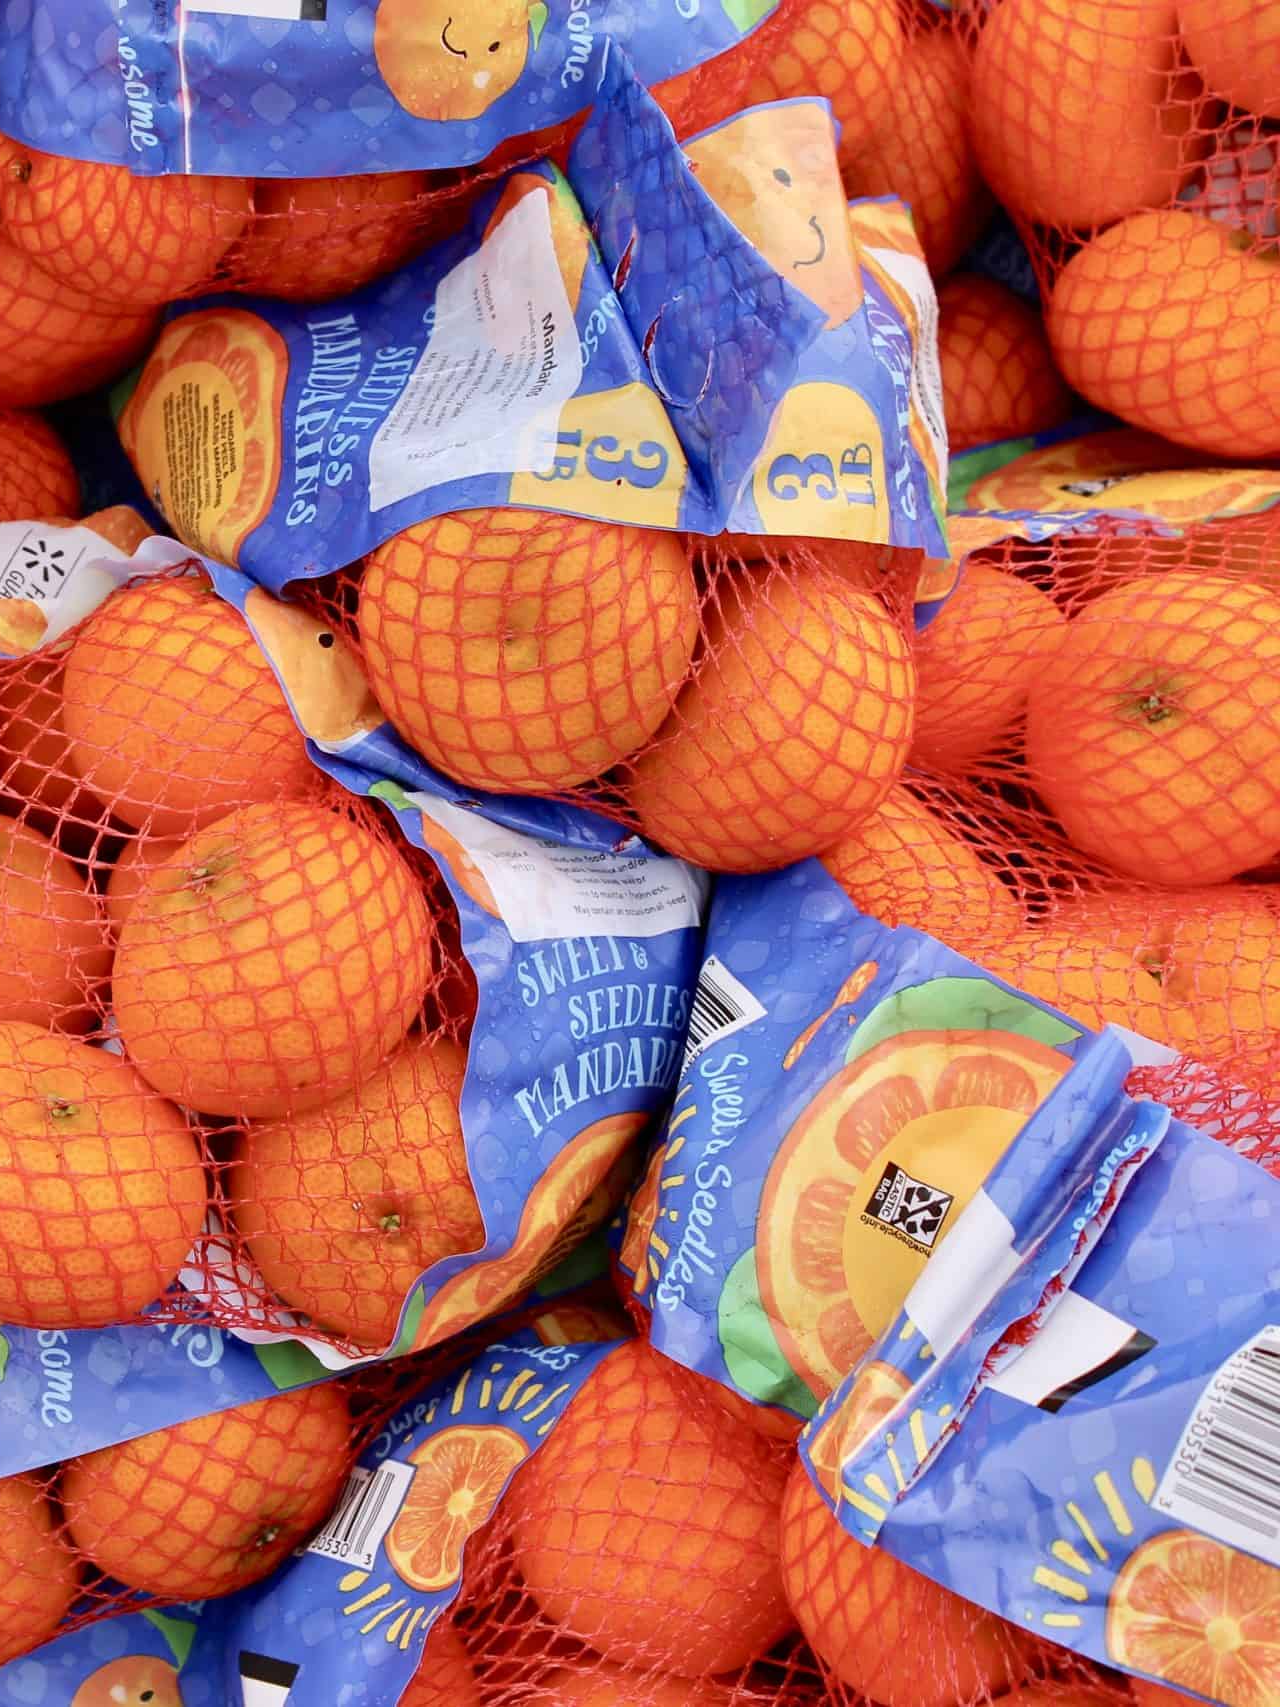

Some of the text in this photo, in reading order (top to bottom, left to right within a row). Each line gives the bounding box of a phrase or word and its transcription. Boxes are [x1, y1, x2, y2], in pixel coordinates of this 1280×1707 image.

[286, 313, 363, 526] MANDARINS
[325, 346, 419, 487] SEEDLESS
[585, 436, 669, 489] 3
[768, 453, 838, 501] 3
[839, 442, 877, 508] LB
[517, 937, 648, 1008] SWEET &
[567, 983, 691, 1040] SEEDLES
[513, 1036, 675, 1138] MANDARI
[700, 1053, 749, 1131] Sweet
[874, 1177, 892, 1201] BAG
[881, 1173, 905, 1218] PLASTIC
[656, 1161, 733, 1311] Seedless
[1174, 1410, 1214, 1476] 30530
